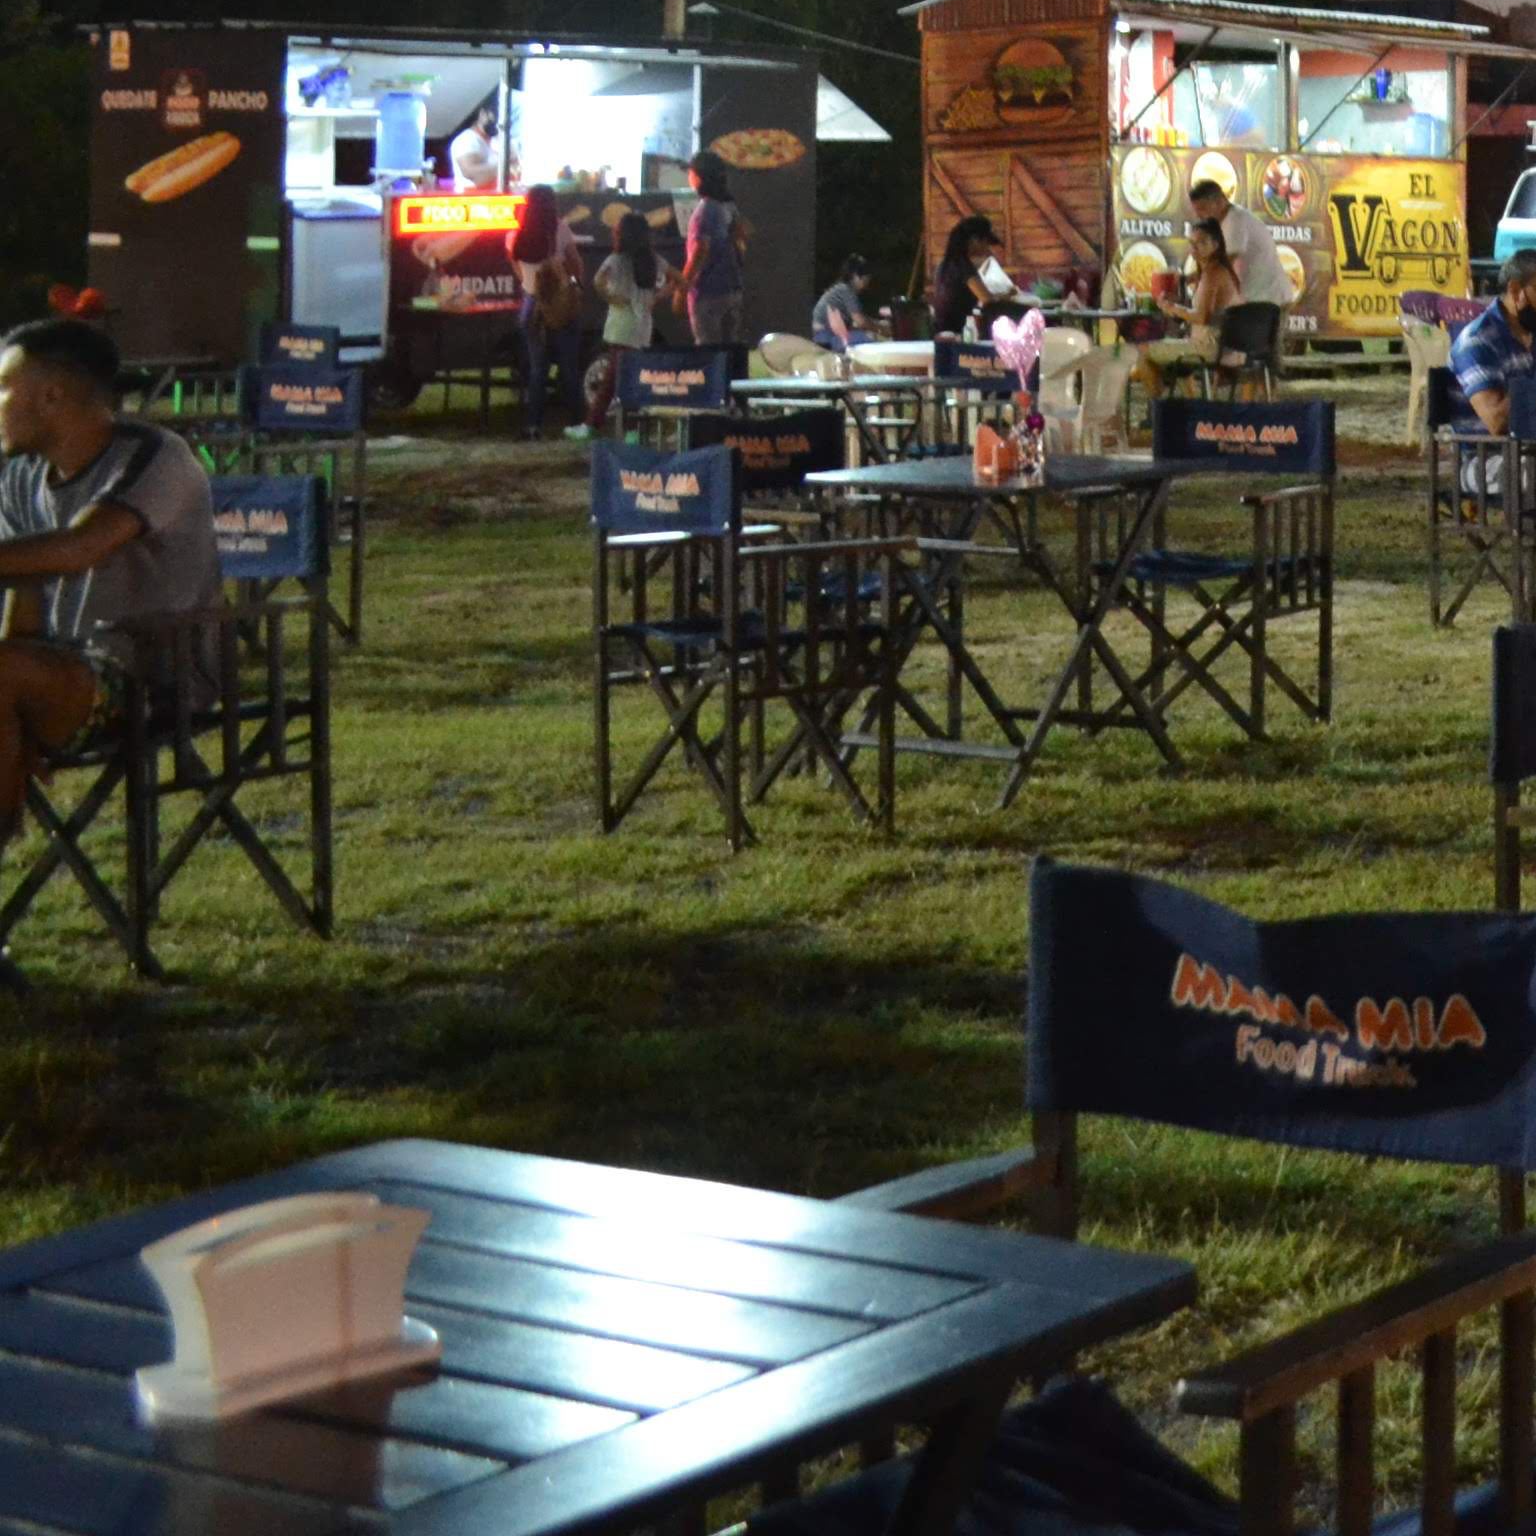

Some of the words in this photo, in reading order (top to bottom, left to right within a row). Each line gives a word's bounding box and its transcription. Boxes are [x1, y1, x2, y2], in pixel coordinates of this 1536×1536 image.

[208, 90, 269, 110] PANCHO
[1409, 173, 1436, 199] EL
[1121, 218, 1172, 236] ALITOS
[1266, 225, 1312, 241] BIDAS
[1335, 294, 1401, 314] FOODT
[1288, 316, 1318, 331] ER'S
[1195, 421, 1257, 443] MAMA
[1259, 425, 1298, 444] MIA
[1355, 992, 1487, 1051] MIA
[1234, 1024, 1319, 1081] Food
[1320, 1042, 1418, 1089] Truck
